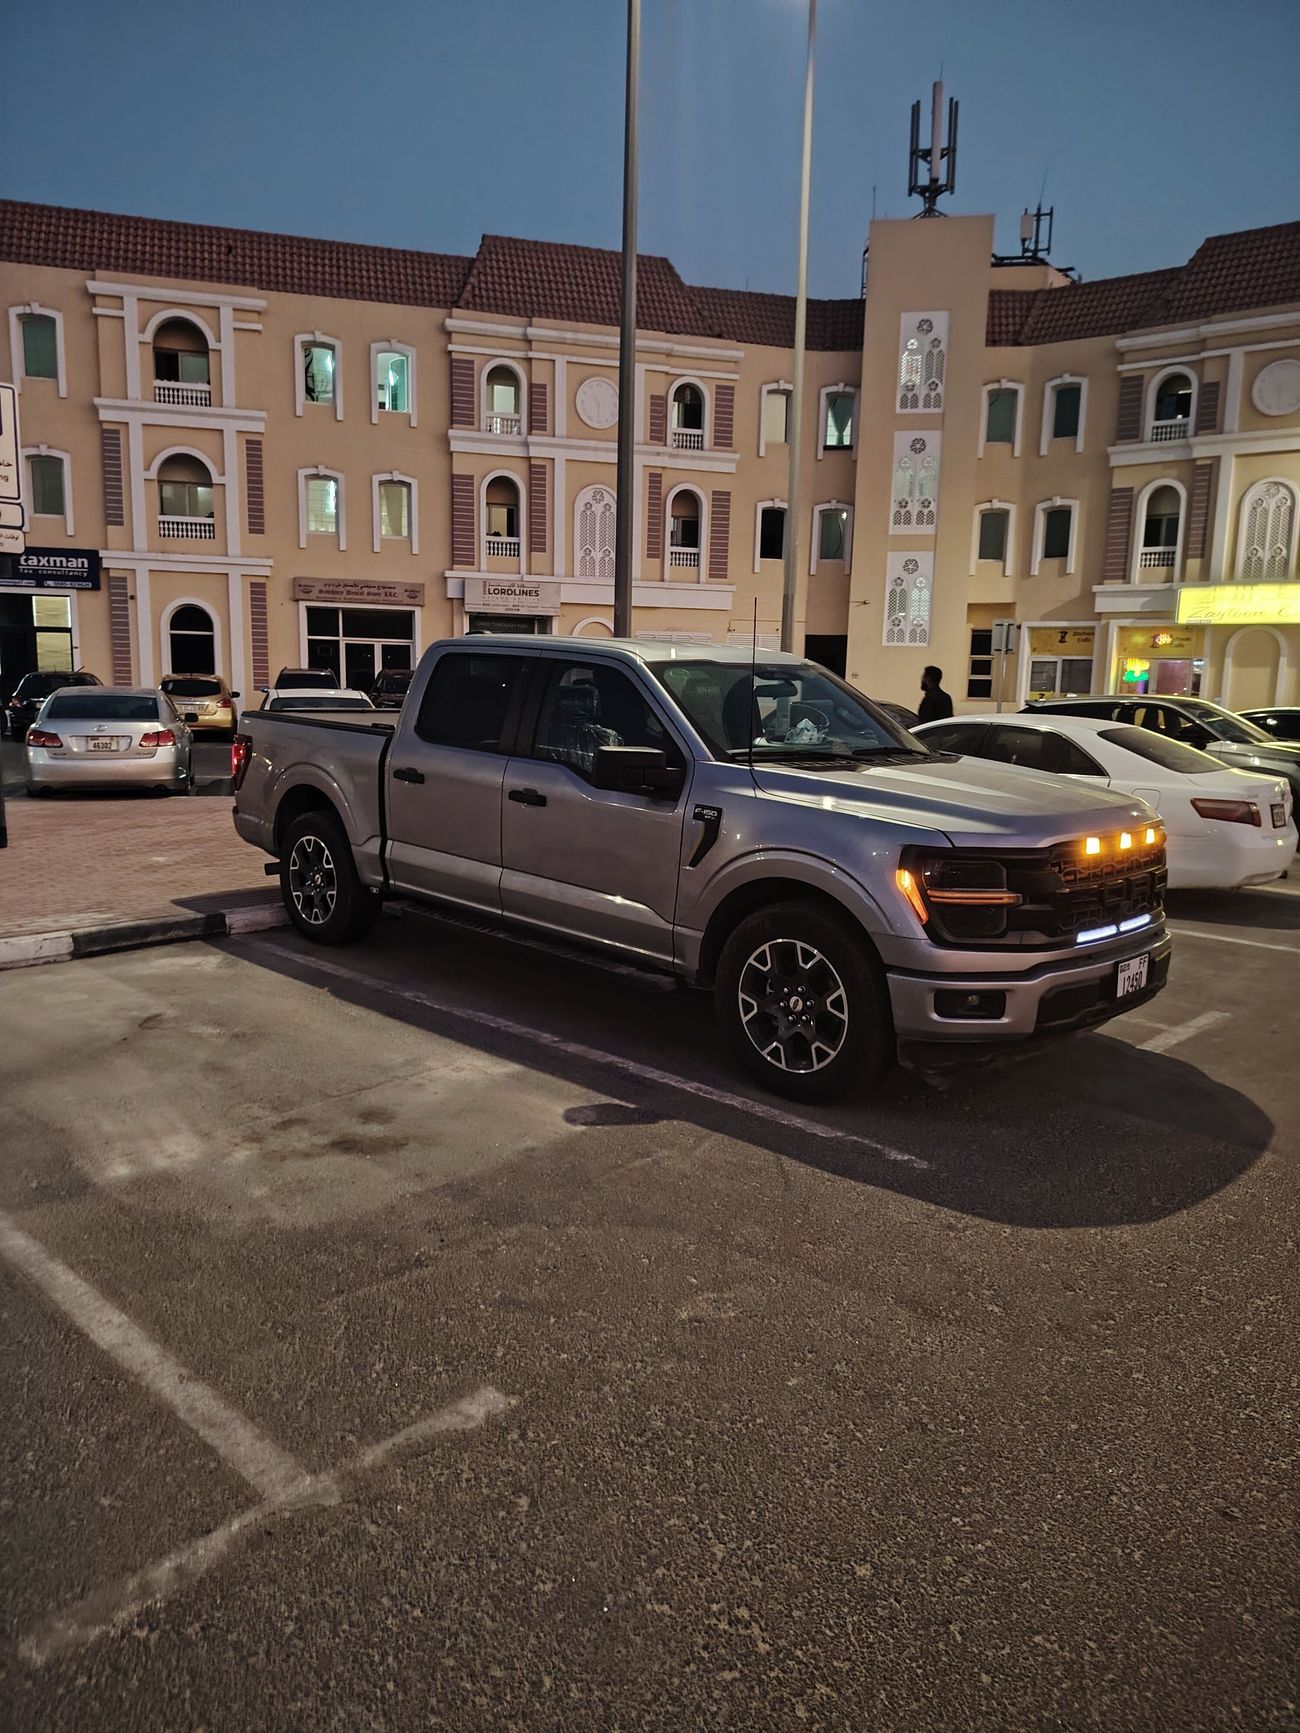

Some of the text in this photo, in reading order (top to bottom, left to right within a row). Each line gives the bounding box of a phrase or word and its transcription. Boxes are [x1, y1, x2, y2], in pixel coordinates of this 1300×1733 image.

[20, 554, 89, 569] taxman
[488, 587, 540, 597] LORDLINES
[695, 808, 717, 817] F-150
